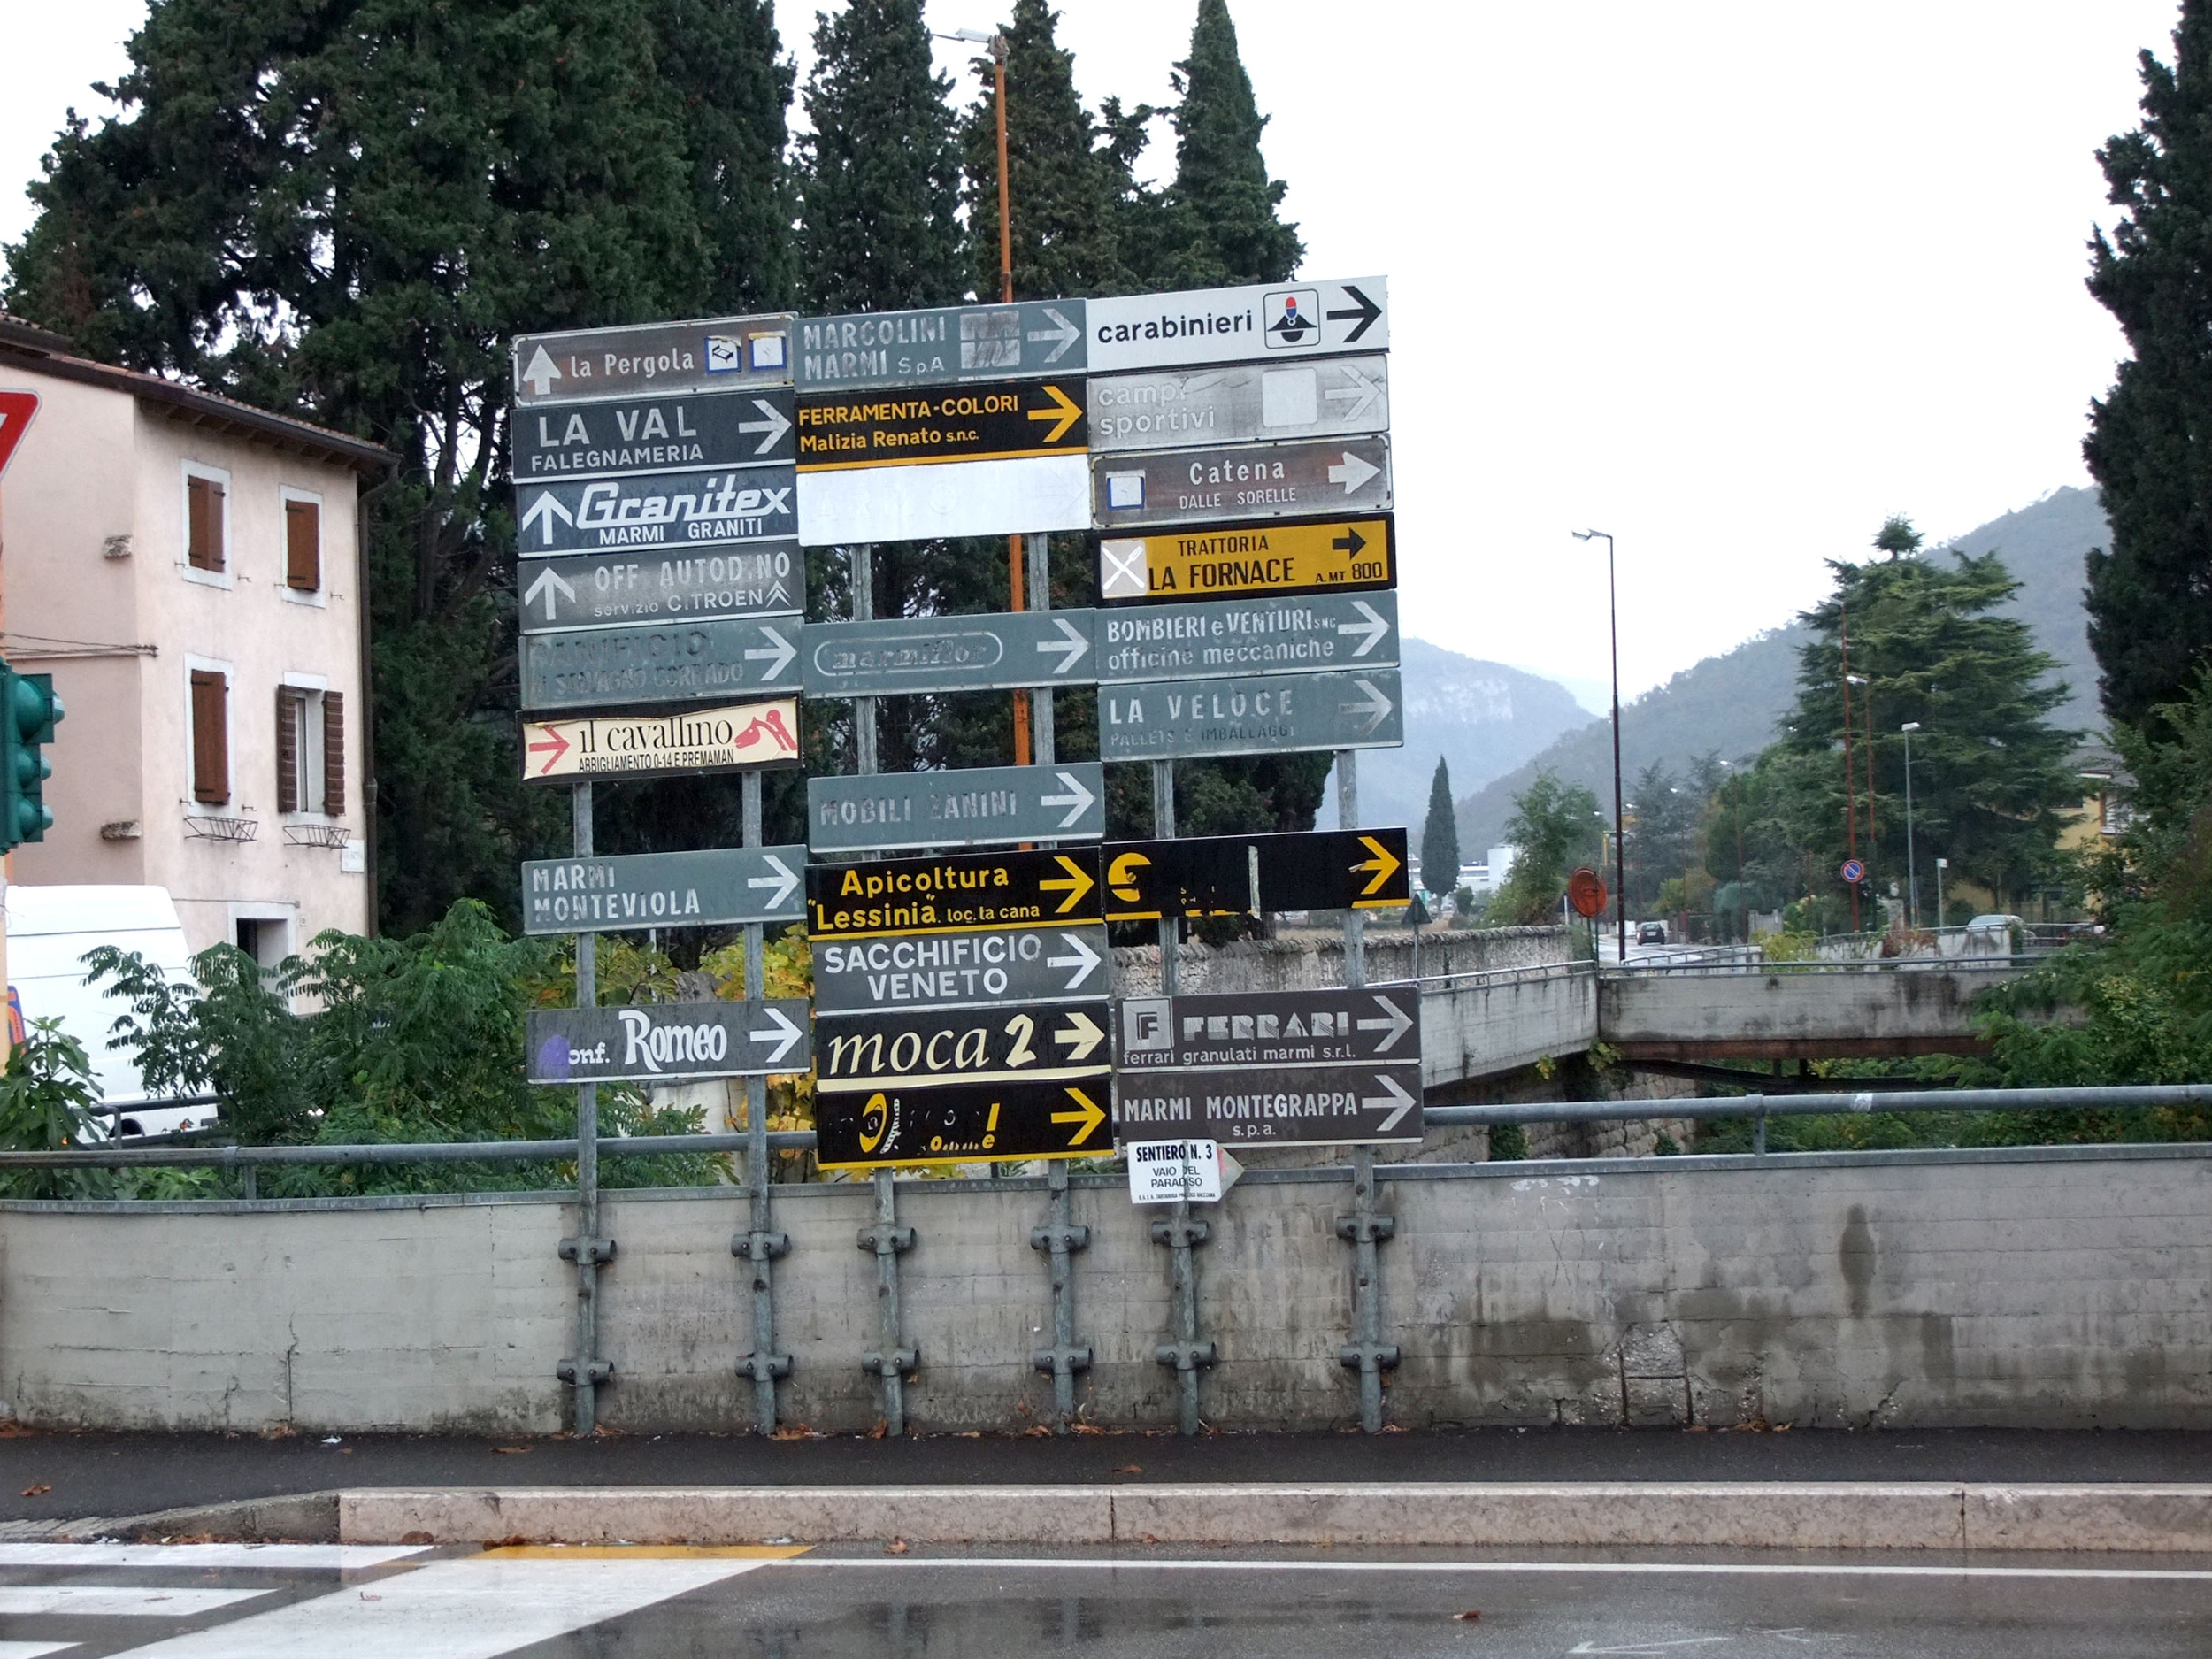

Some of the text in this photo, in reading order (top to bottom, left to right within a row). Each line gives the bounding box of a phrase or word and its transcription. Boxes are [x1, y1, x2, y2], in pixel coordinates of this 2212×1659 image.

[803, 316, 945, 350] MARCOLINI
[1097, 310, 1252, 343] carabinieri
[571, 348, 695, 379] la Pergola
[804, 349, 887, 380] MARMI
[1098, 382, 1187, 407] campi
[798, 395, 1019, 426] FERRAMENTA-COLORI
[1099, 405, 1215, 437] sportivi
[538, 406, 697, 448] LA VAL
[800, 427, 979, 453] Malizia Renato s.n.c.
[531, 444, 704, 472] FALEGNAMERIA
[1189, 459, 1286, 486] Catena
[576, 475, 793, 530] Granitex
[1179, 488, 1297, 510] DALLE SORELLE
[599, 518, 763, 545] MARMI GRANITI
[1177, 535, 1270, 557] TRATTORIA
[595, 564, 639, 592] OFF
[1148, 557, 1296, 591] LA FORNACE
[1351, 562, 1383, 580] 800
[667, 588, 764, 611] CTROEN
[1107, 615, 1206, 643] BOMBIERI
[1211, 621, 1225, 636] e
[1225, 608, 1313, 634] VENTURI
[1108, 635, 1334, 671] officine meccaniche
[1110, 689, 1294, 725] LA VELOCE
[607, 716, 733, 752] cavallino
[579, 749, 734, 773] ABBIGLIAMENTO 0-14 E PREMAMAN
[821, 790, 1017, 826] MOBILI ZANINI
[533, 864, 616, 893] MARMI
[841, 867, 1010, 898] Apicoltura
[534, 887, 701, 923] MONTEVIOLA
[979, 906, 995, 921] la
[999, 905, 1041, 919] cana
[824, 933, 1041, 974] SACCHIFICIO
[867, 967, 1009, 1002] VENETO
[568, 1009, 727, 1073] onf. Romeo
[1183, 1011, 1349, 1041] FERRARI
[828, 1013, 1037, 1076] moca 2
[1123, 1044, 1356, 1066] ferrari granulati marmi s.r.l.
[1124, 1092, 1357, 1123] MARMI MONTEGRAPPA
[1232, 1124, 1277, 1139] s.p.a.
[1136, 1143, 1213, 1163] SENTIERO N. 3
[1150, 1177, 1203, 1188] PARADISO
[1152, 1165, 1201, 1177] VAIO DEL
